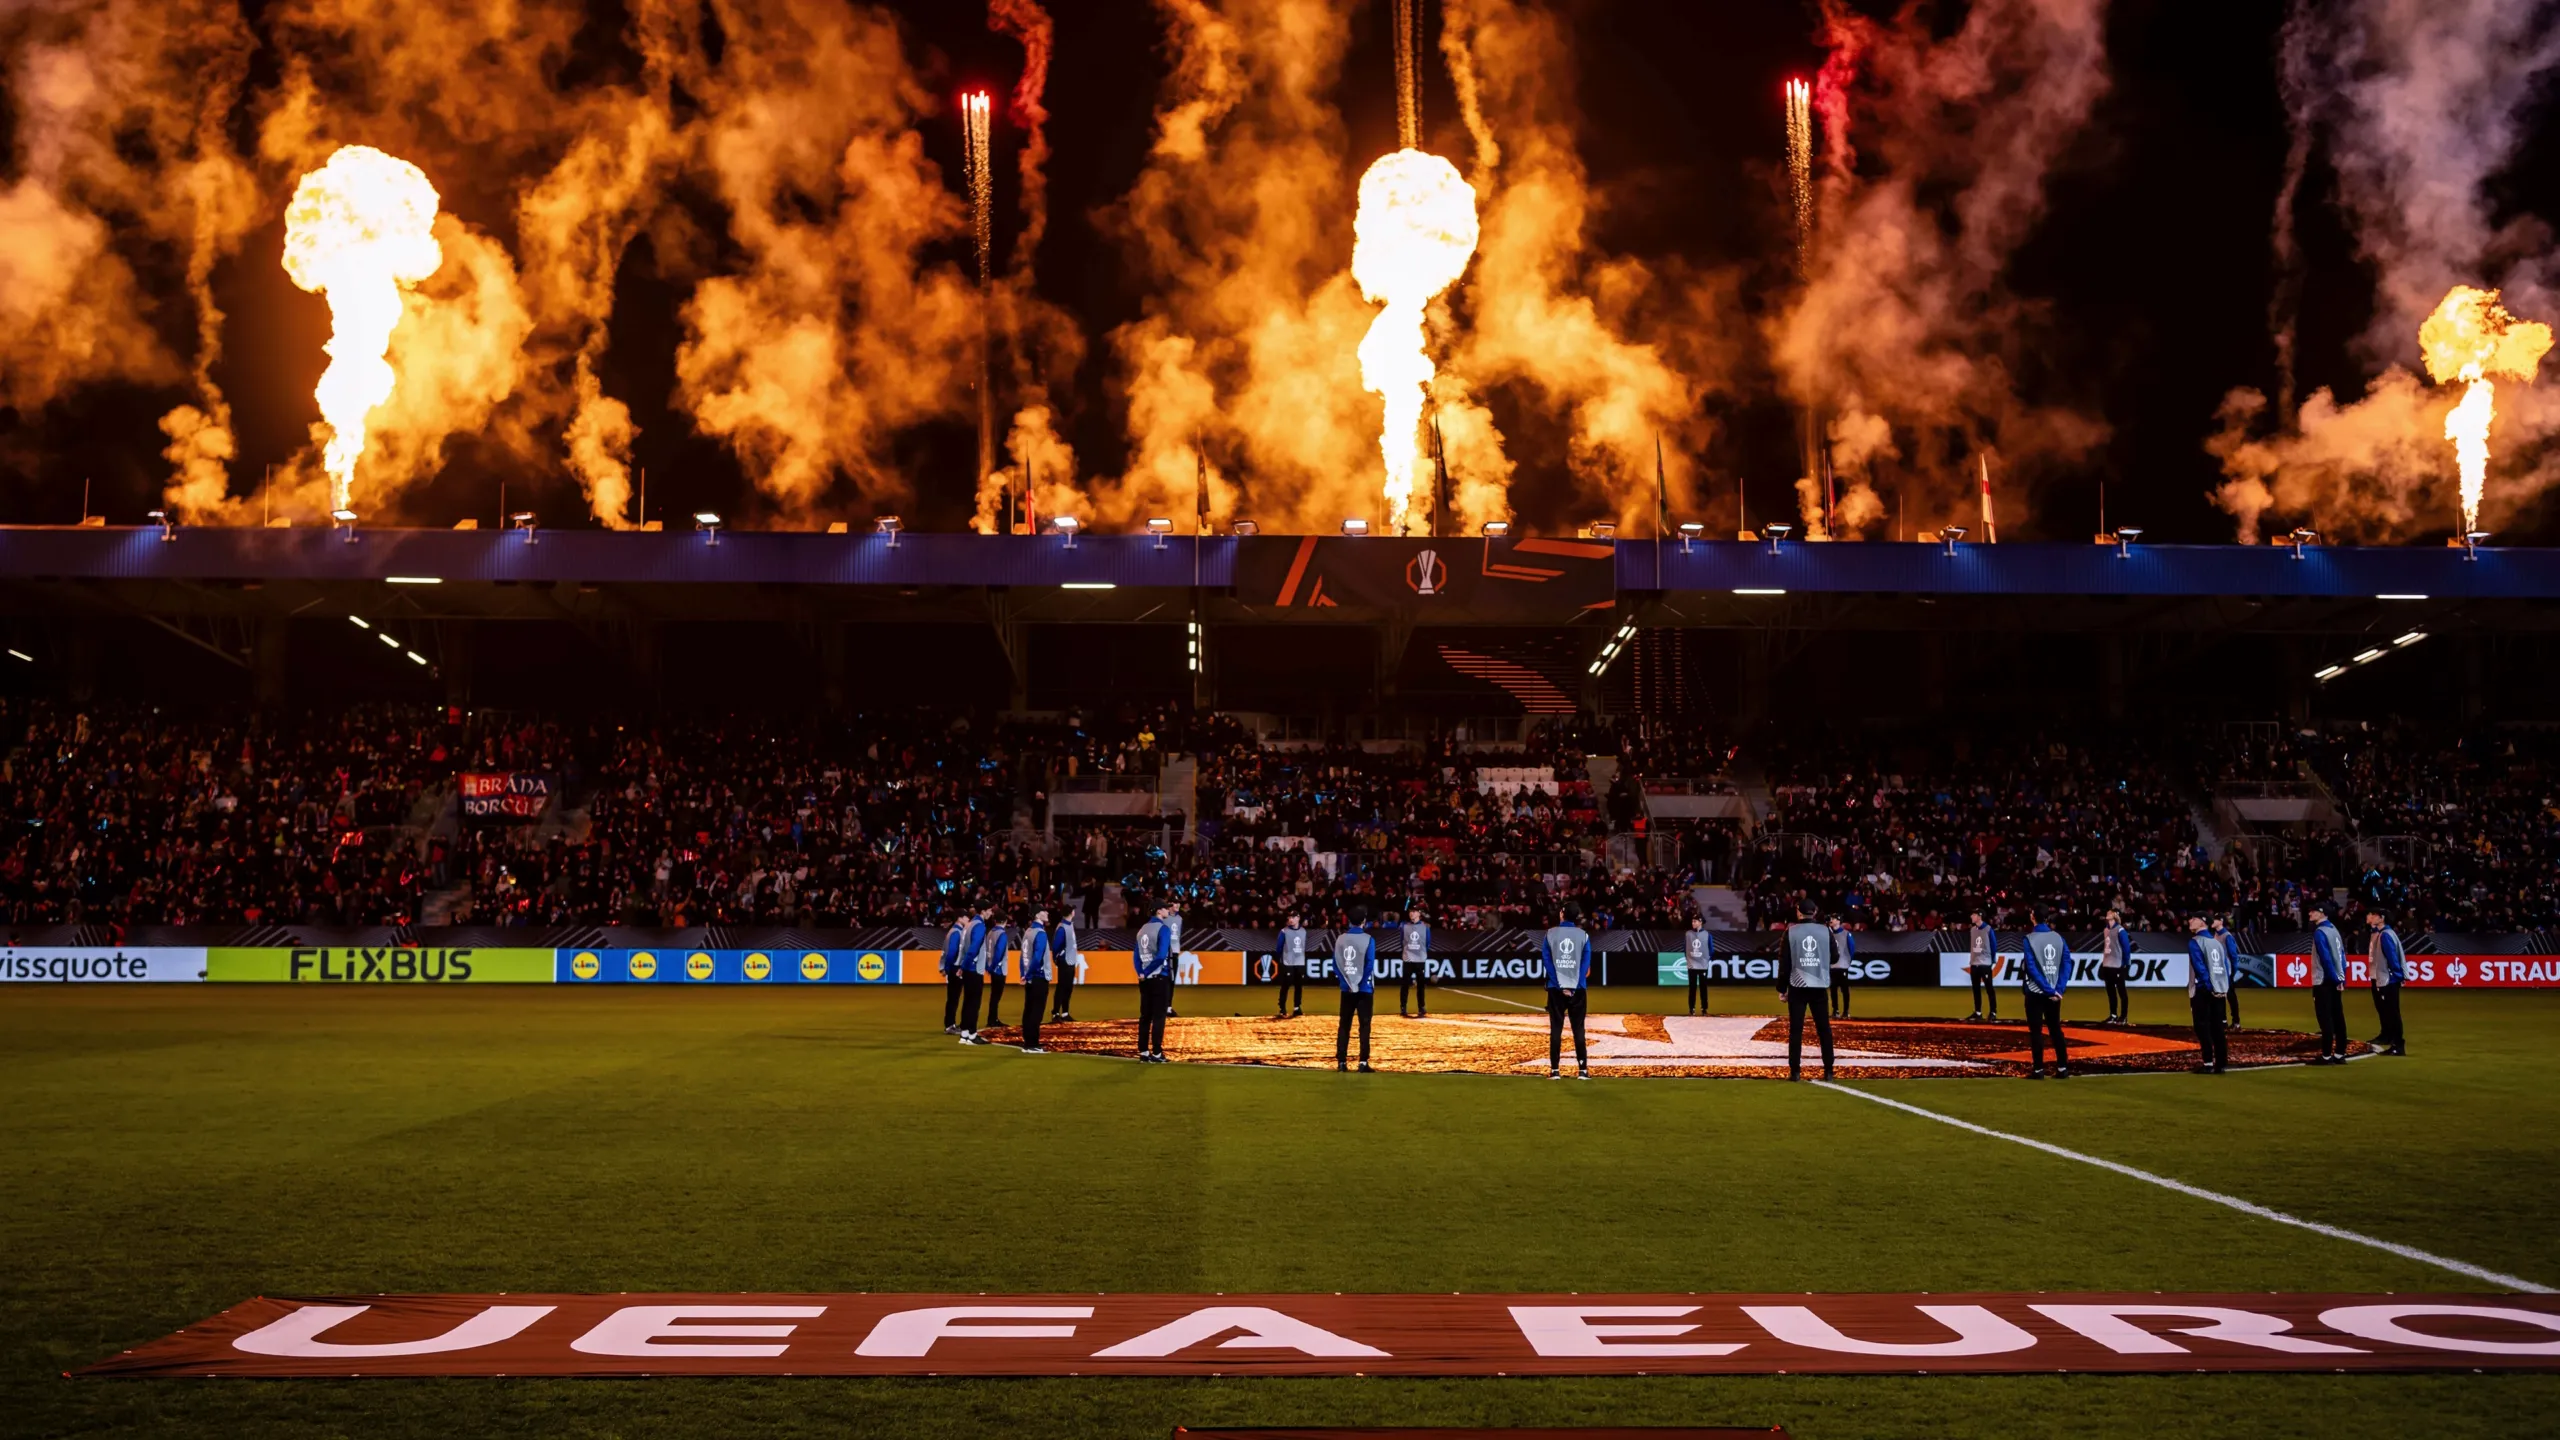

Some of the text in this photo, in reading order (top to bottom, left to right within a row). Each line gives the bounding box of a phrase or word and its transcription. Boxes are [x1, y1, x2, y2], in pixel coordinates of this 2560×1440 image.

[0, 950, 147, 982] issquote
[1373, 958, 1456, 978] URPA
[232, 1306, 1393, 1357] UEFA
